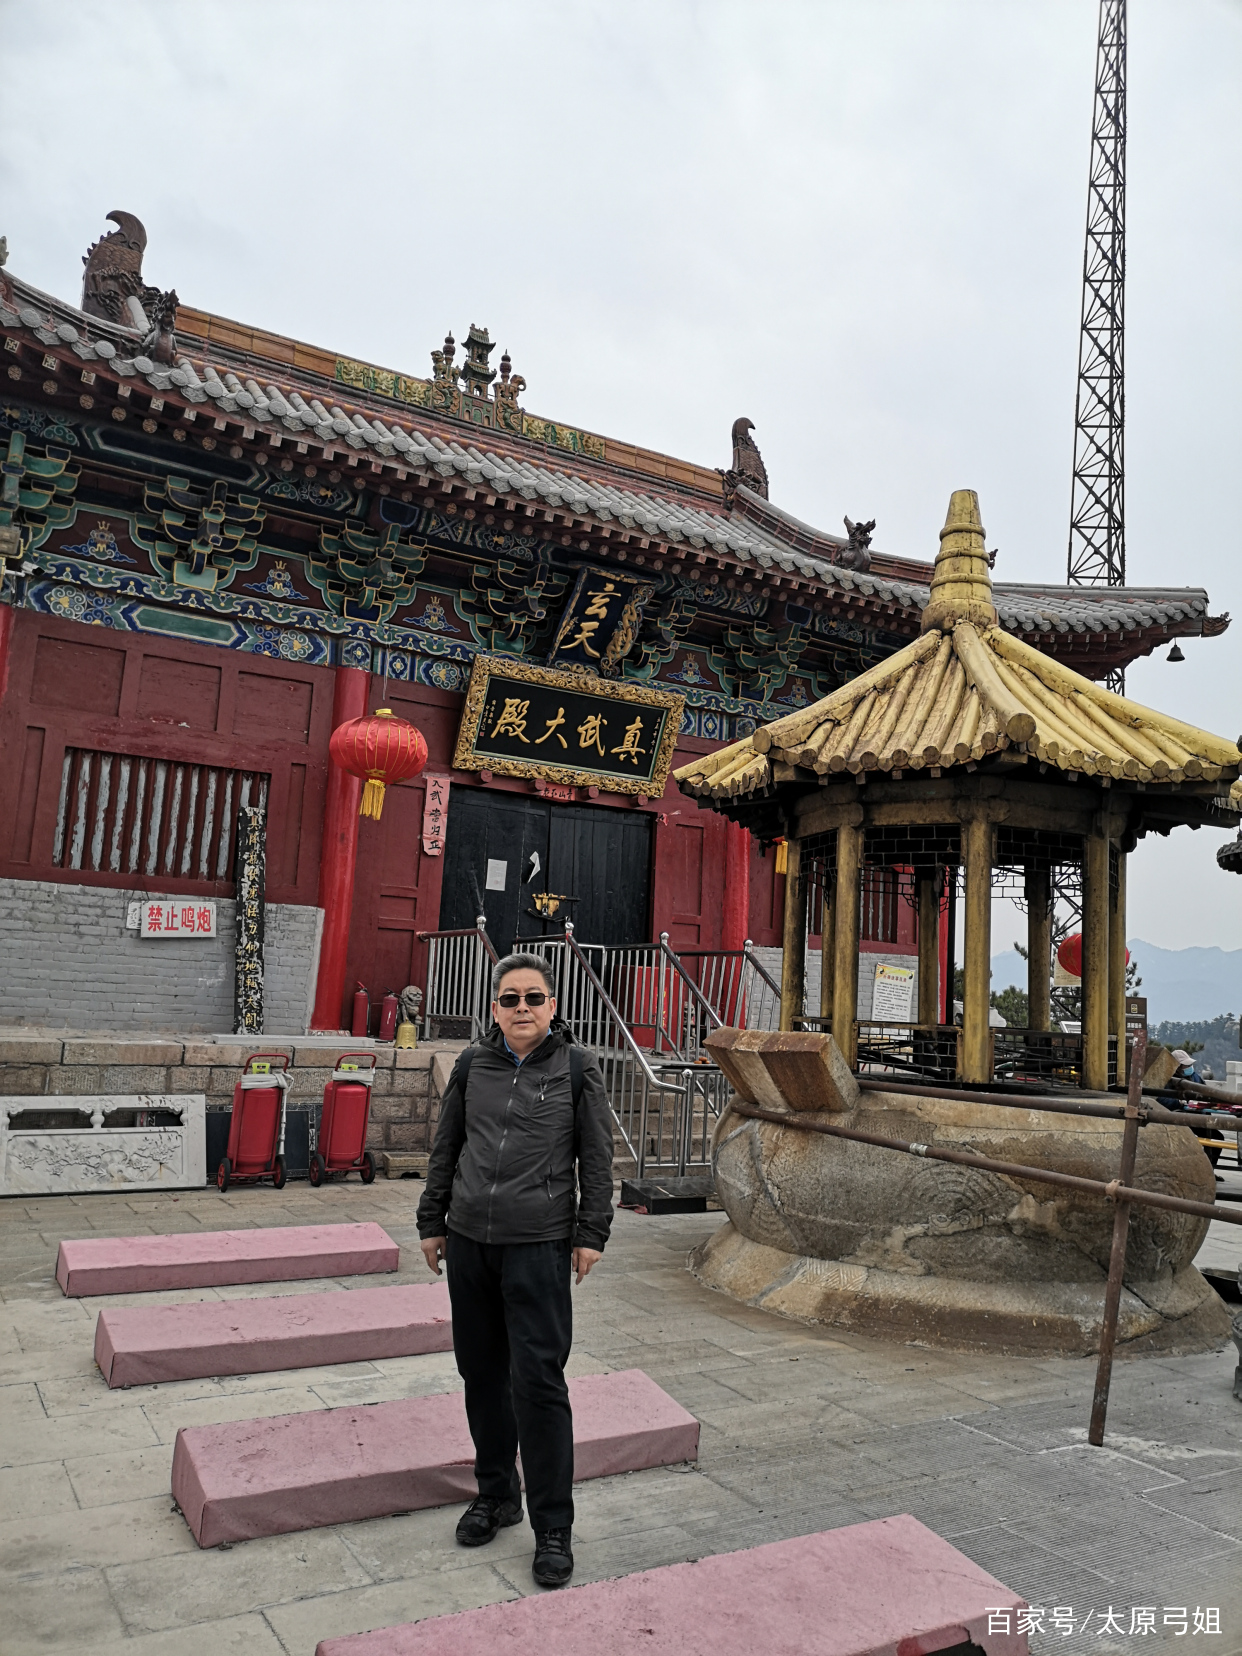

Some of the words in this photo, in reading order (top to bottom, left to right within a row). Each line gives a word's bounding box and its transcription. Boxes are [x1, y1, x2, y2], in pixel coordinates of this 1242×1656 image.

[560, 583, 622, 659] 玄天
[491, 698, 646, 765] 真武大殿
[147, 905, 211, 933] 禁止鸣炮
